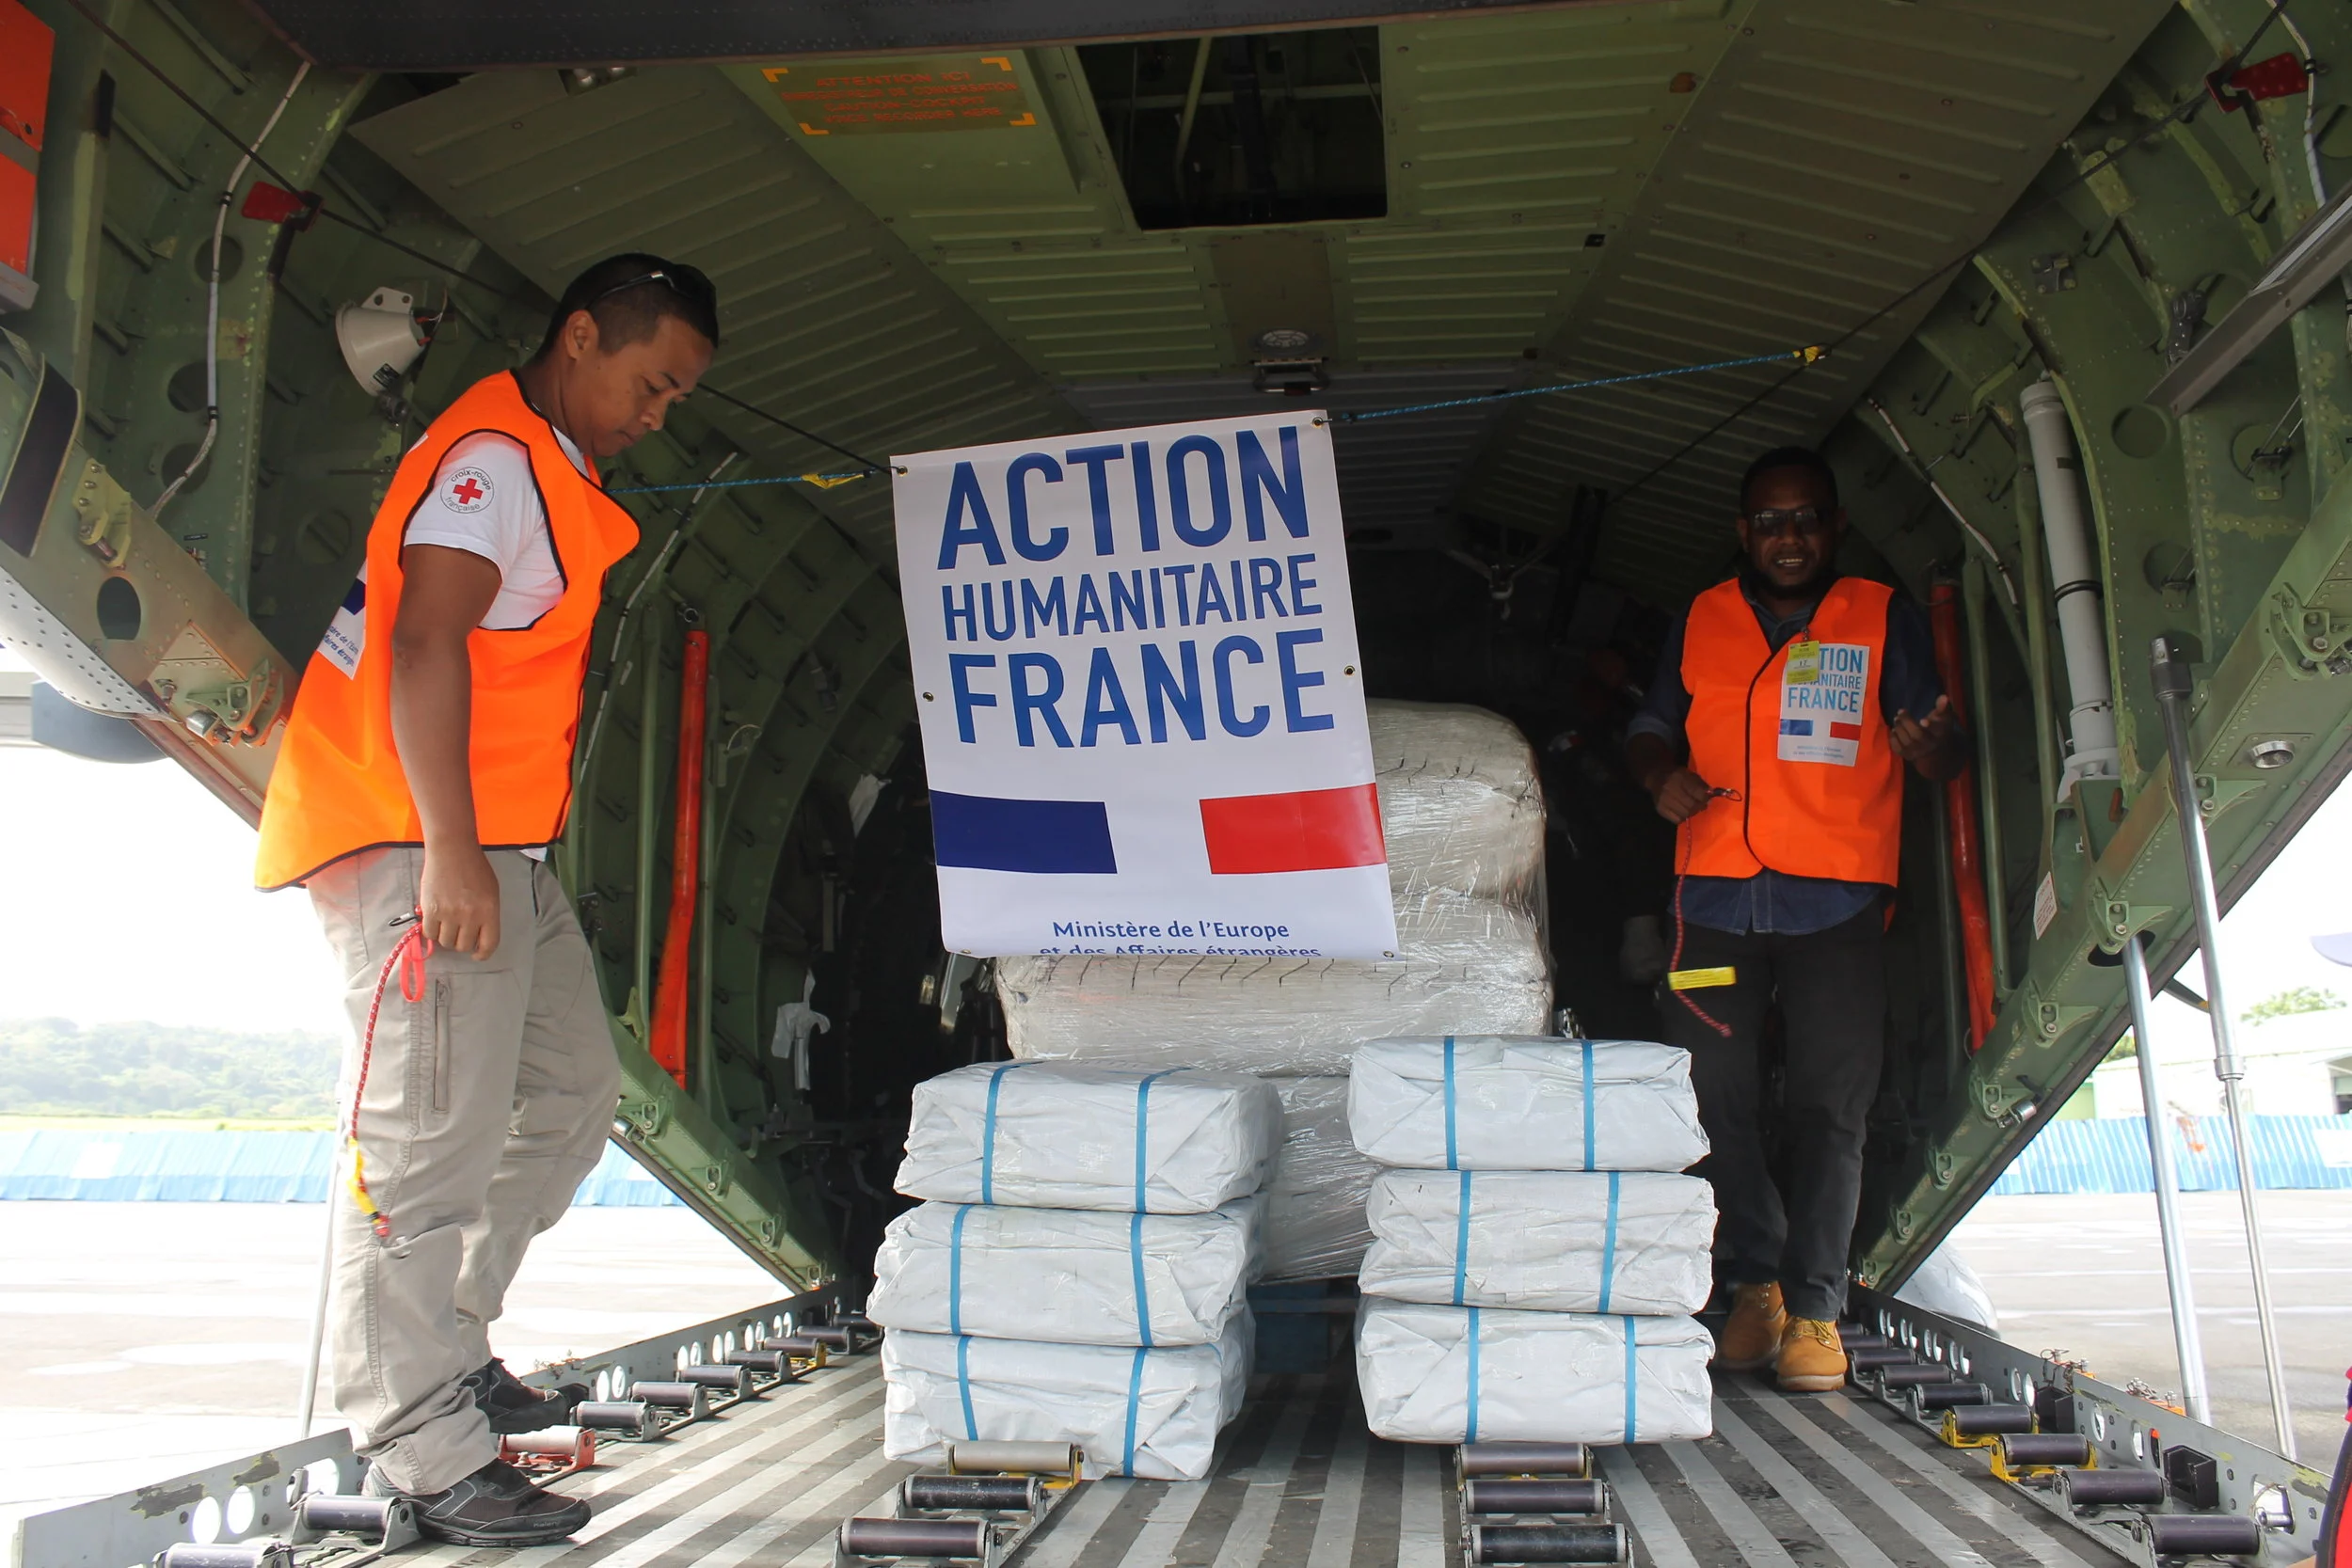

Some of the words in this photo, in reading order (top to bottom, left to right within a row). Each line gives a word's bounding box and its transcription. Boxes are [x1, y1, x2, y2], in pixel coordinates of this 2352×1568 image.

[816, 73, 932, 87] ATTENTION
[942, 71, 972, 82] ICI
[912, 82, 1019, 96] CONVERSATION
[823, 112, 869, 124] VOICE
[874, 108, 955, 123] RECORDER
[961, 106, 1003, 119] HERE
[451, 469, 491, 490] croix-rouge
[938, 426, 1309, 569] ACTION
[942, 553, 1322, 641] HUMANITAIRE
[1820, 647, 1863, 673] TION
[948, 628, 1334, 748] FRANCE
[1797, 673, 1862, 689] NITAIRE
[1788, 687, 1860, 713] FRANCE
[1053, 921, 1162, 938] Ministère
[1167, 921, 1195, 938] de
[1200, 921, 1290, 942] l'Europe
